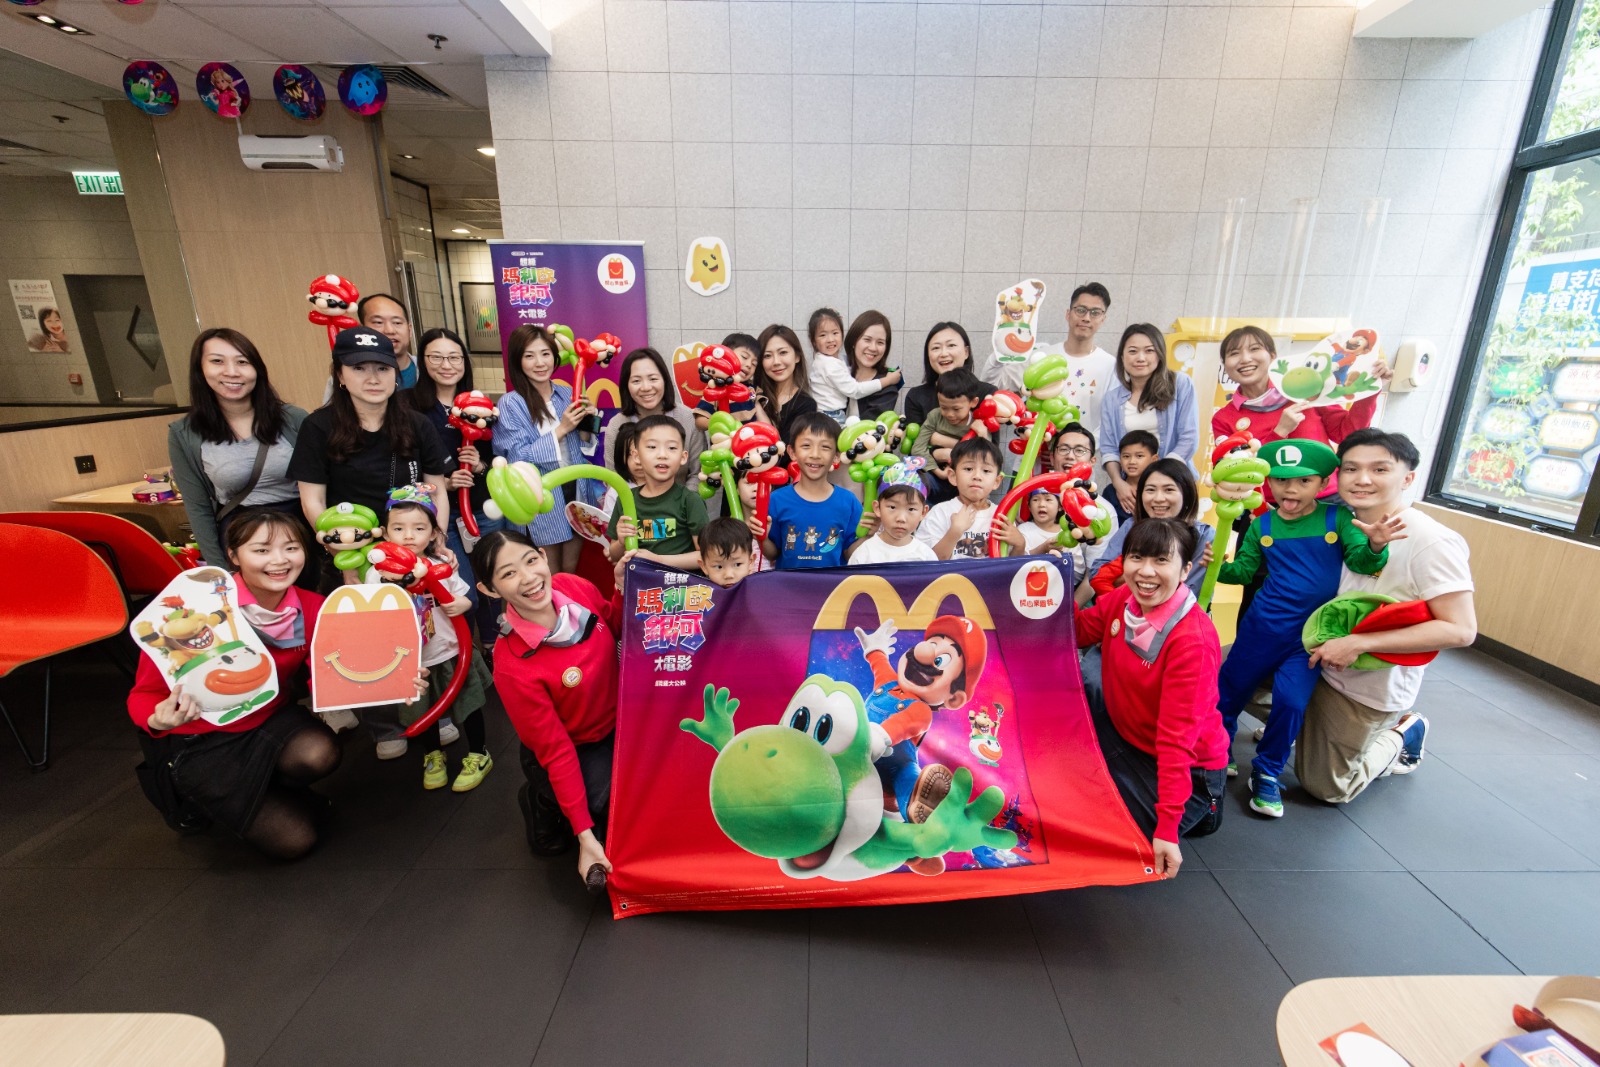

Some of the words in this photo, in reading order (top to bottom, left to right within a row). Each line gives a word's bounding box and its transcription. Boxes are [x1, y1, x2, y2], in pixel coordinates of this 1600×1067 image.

[75, 175, 103, 193] EXIT
[518, 308, 547, 319] 大電影
[1280, 449, 1297, 464] L
[664, 572, 689, 585] 超級
[635, 584, 716, 617] 瑪利歐
[642, 613, 707, 653] 銀河
[654, 655, 693, 672] 大電影
